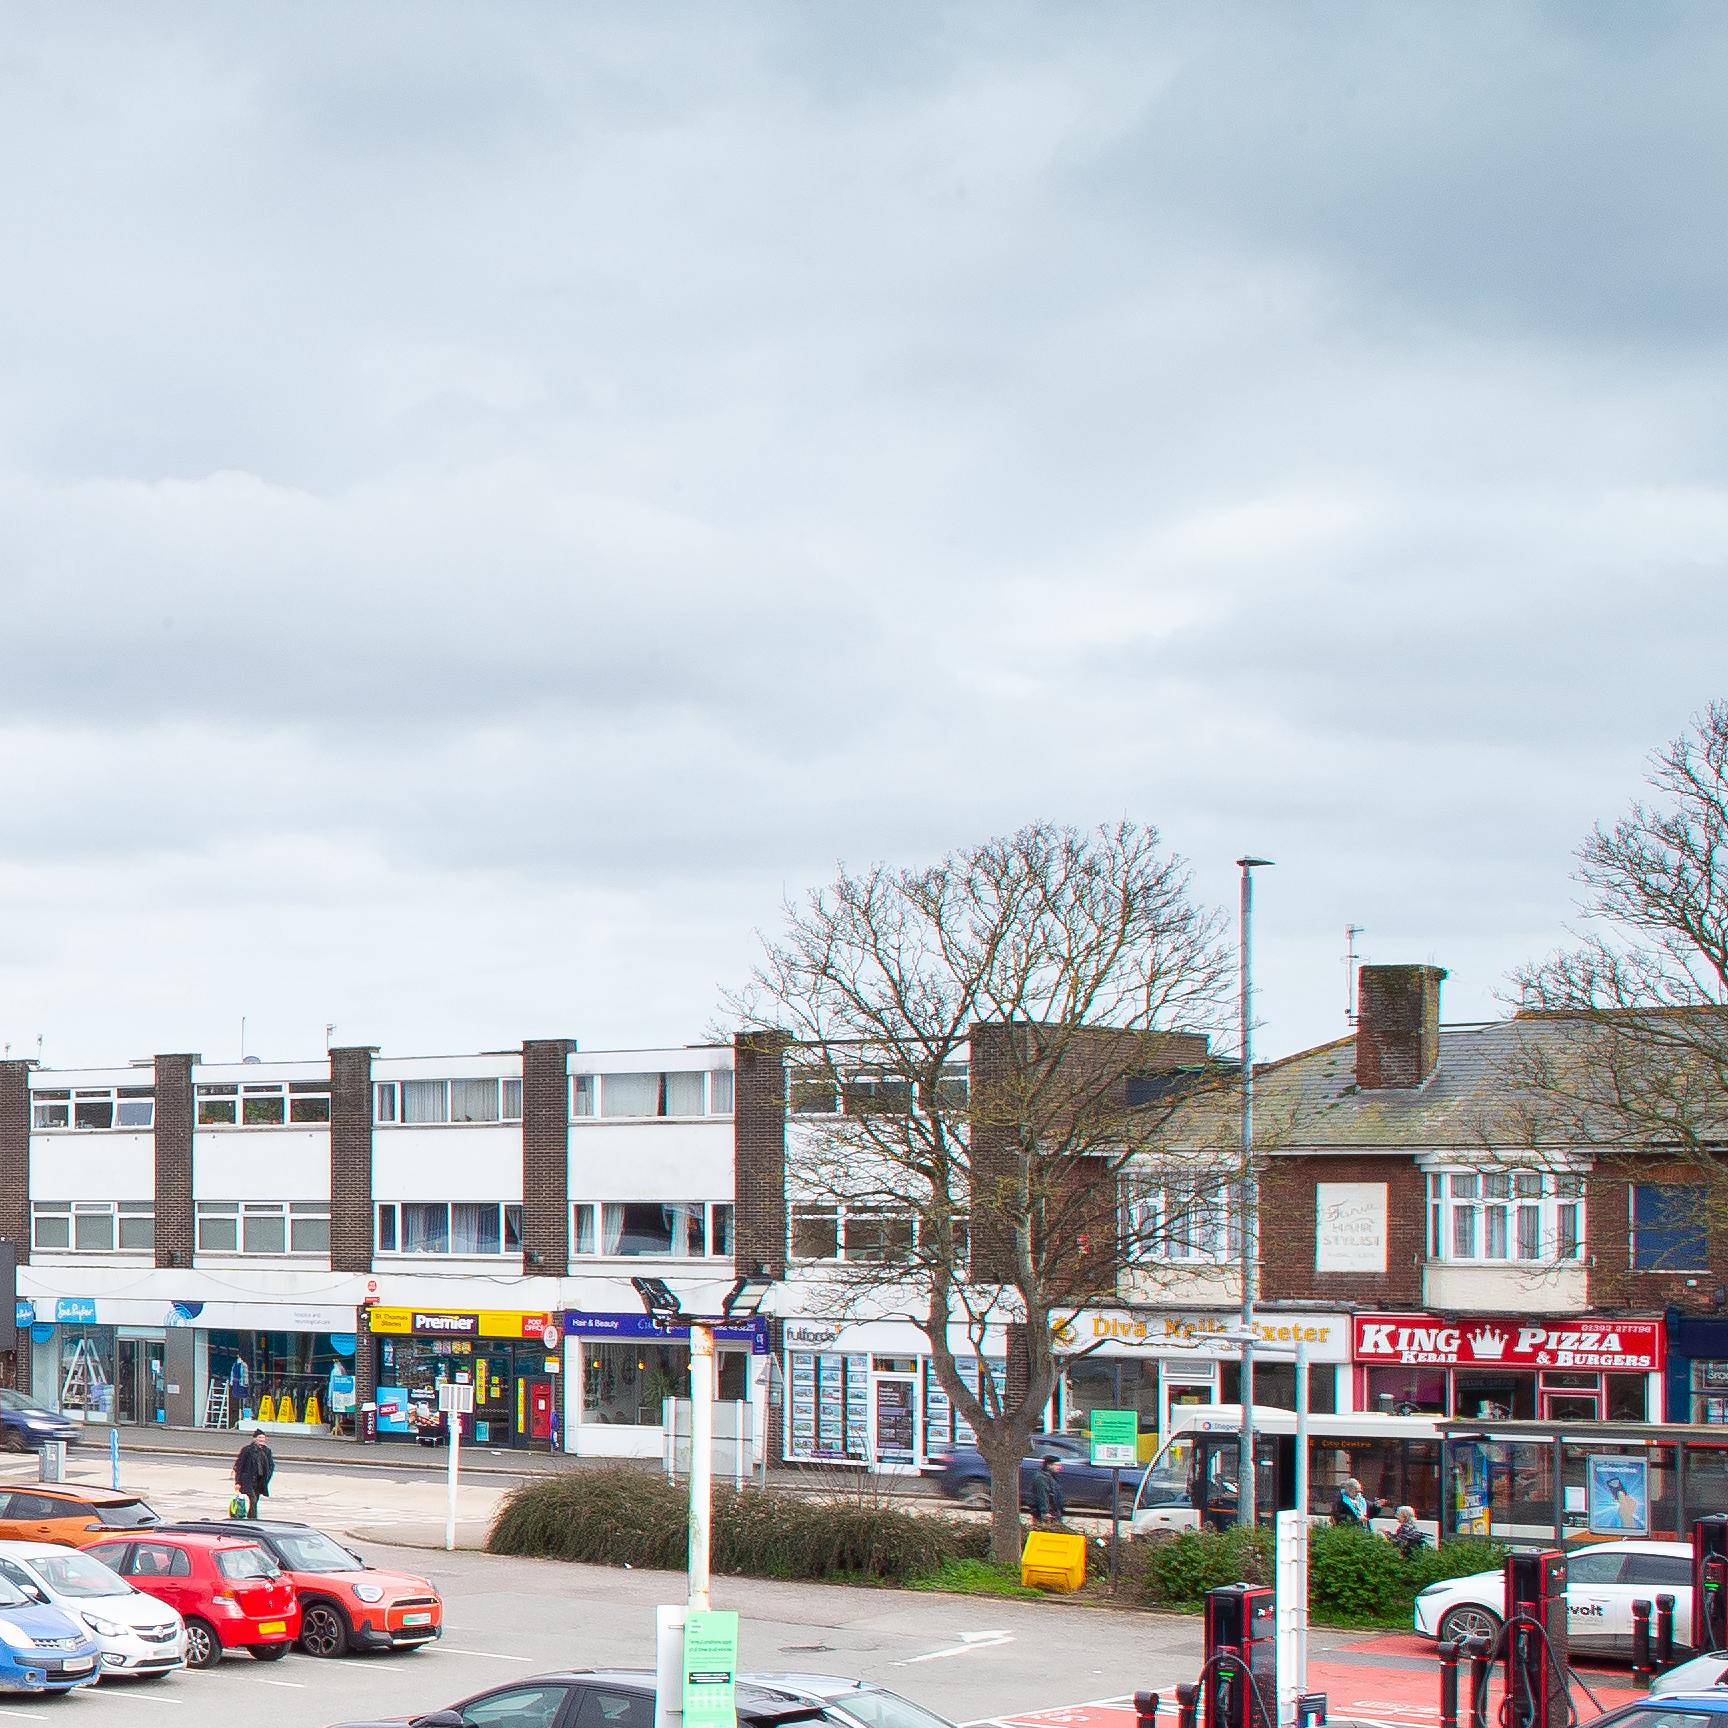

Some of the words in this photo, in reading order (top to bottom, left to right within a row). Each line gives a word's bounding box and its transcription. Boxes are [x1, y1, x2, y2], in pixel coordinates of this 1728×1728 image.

[415, 1313, 474, 1330] Premier
[572, 1318, 587, 1327] Hair
[588, 1319, 594, 1327] &
[595, 1319, 619, 1329] Beauty
[1092, 1318, 1146, 1338] Diva
[1359, 1323, 1462, 1354] KING
[1513, 1326, 1622, 1352] PIZZA
[1400, 1351, 1458, 1364] KEBAB
[1536, 1351, 1551, 1364] &
[1555, 1351, 1650, 1367] BURGERS
